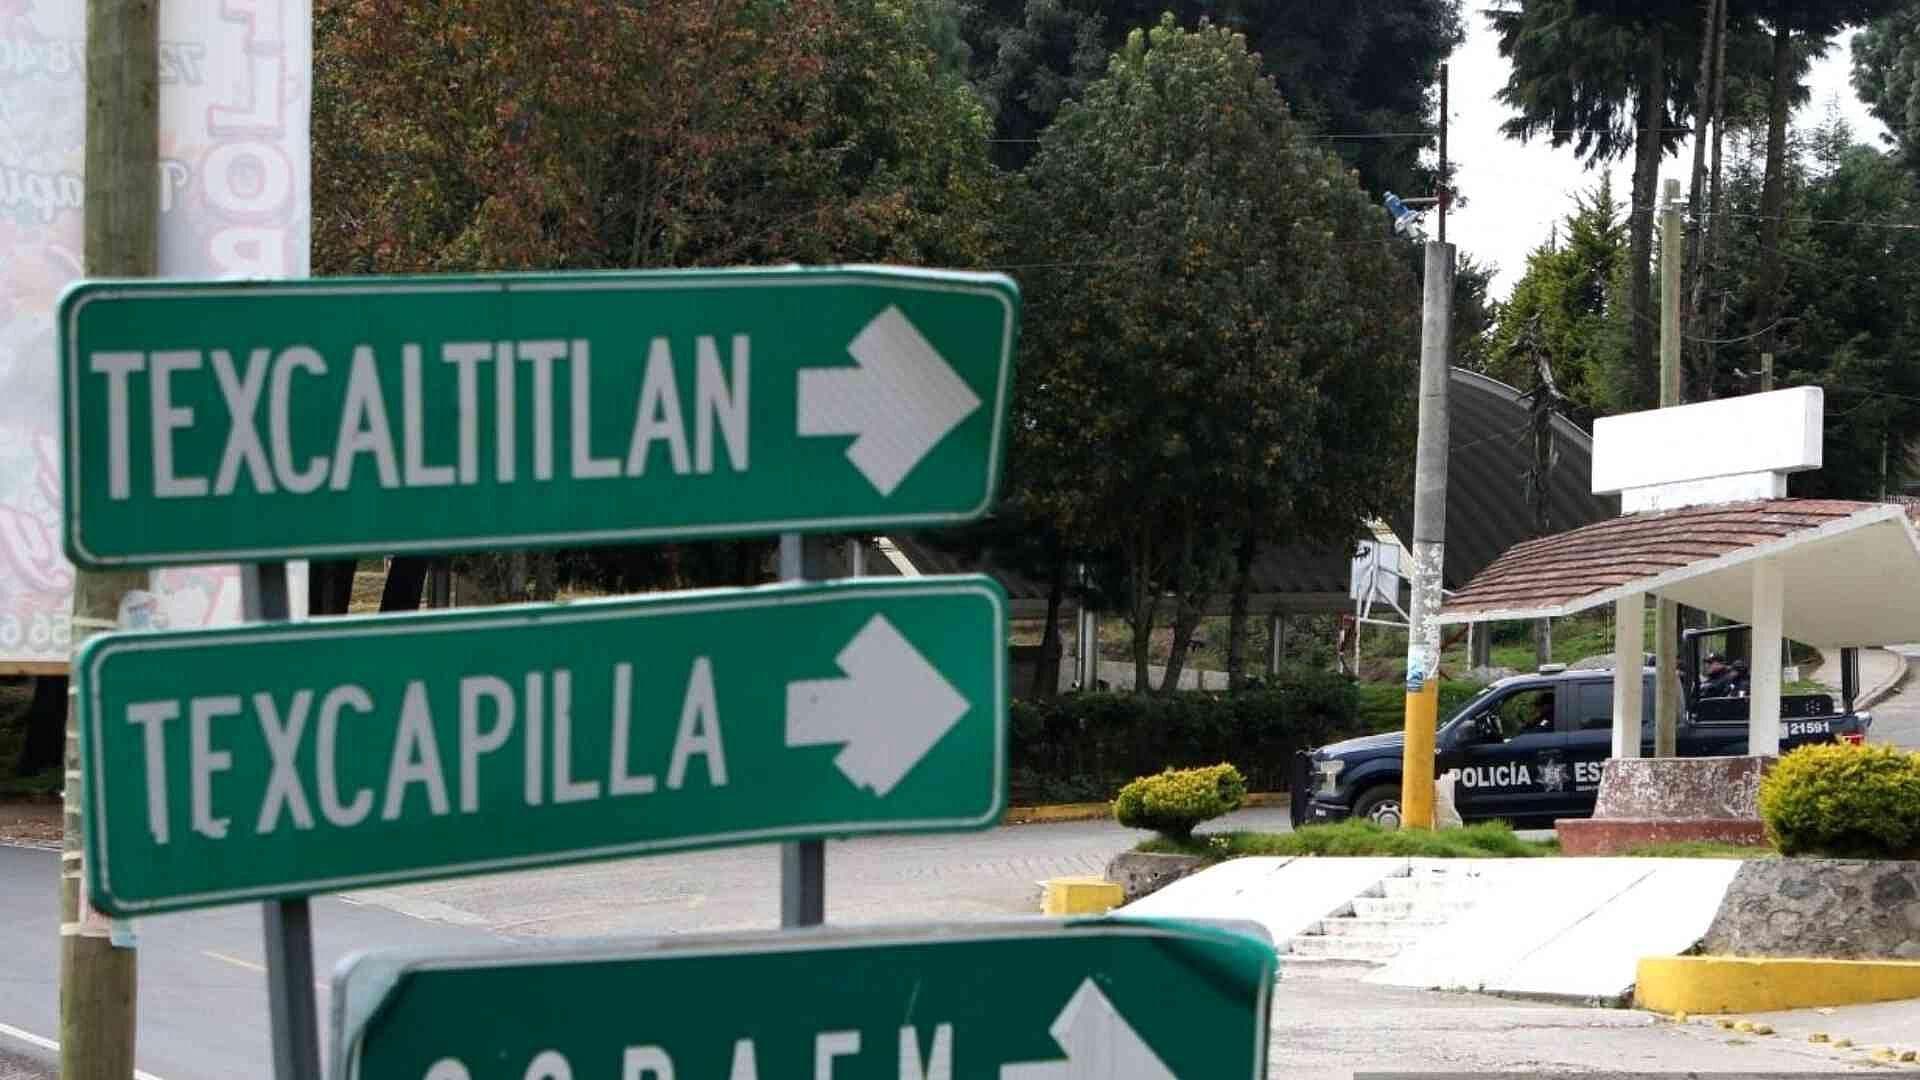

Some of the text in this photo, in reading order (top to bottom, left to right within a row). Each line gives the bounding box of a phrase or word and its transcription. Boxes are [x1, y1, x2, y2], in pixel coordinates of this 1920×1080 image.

[90, 333, 751, 500] TEXCALTITLAN
[125, 656, 729, 846] TEXCAPILLA
[1448, 761, 1532, 788] POLICÍA
[1790, 721, 1830, 736] 21591
